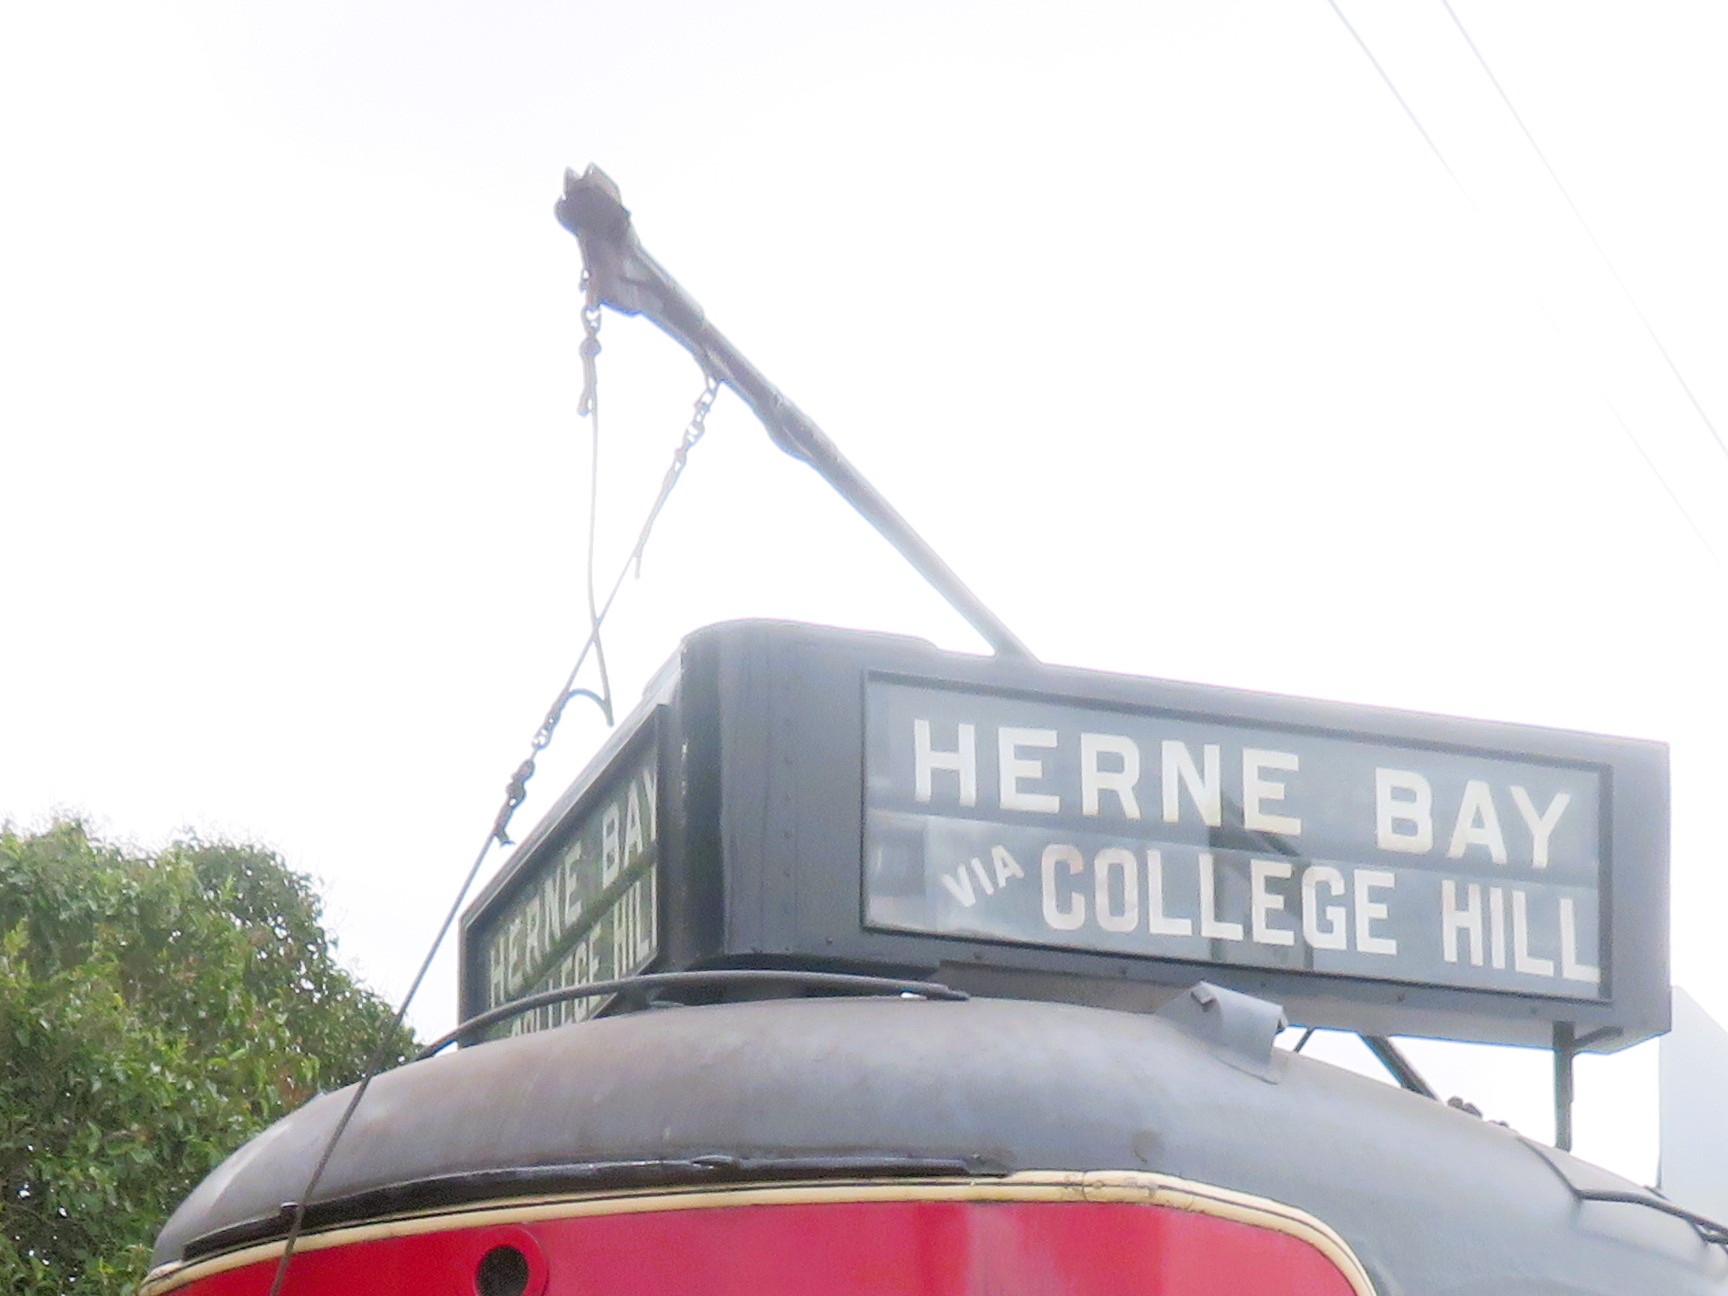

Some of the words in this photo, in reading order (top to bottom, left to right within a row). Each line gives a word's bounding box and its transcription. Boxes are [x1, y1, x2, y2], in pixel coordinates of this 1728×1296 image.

[913, 718, 1302, 836] HERNE
[1377, 771, 1572, 870] BAY
[490, 840, 582, 1011] HERNE
[944, 843, 1026, 908] VIA
[1041, 844, 1399, 954] COLLEGE
[1441, 879, 1600, 983] HILL
